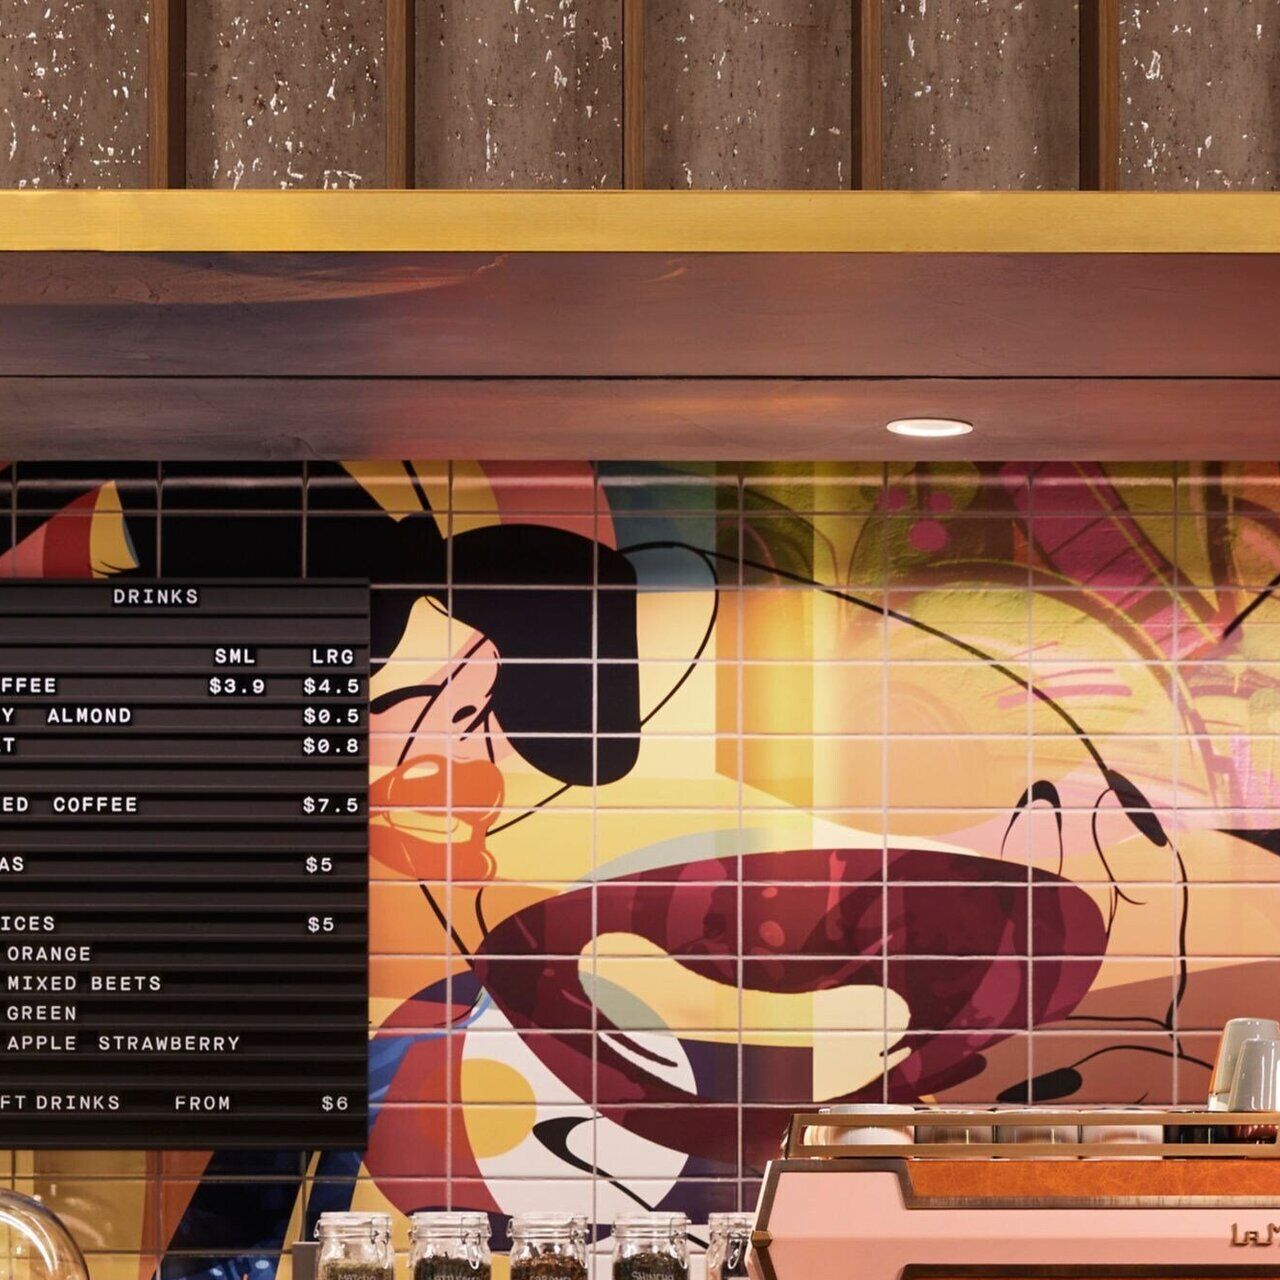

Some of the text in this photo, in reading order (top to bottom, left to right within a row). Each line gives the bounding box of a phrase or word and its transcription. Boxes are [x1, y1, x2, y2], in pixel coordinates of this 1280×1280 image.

[114, 589, 197, 604] DRINKS
[215, 648, 353, 664] SML LRG
[210, 677, 264, 694] $3.9
[304, 677, 358, 694] $4.5
[48, 708, 130, 723] ALMOND
[304, 707, 358, 724] $0.5
[304, 737, 358, 754] $0.8
[54, 797, 136, 812] COFFEE
[304, 797, 357, 813] $7.5
[306, 856, 332, 873] $5
[308, 917, 333, 933] $5
[8, 946, 89, 961] ORANGE
[8, 976, 160, 990] MIXED BEETS
[7, 1006, 75, 1020] GREEN
[8, 1036, 239, 1050] APPLE STRAWBERRY
[37, 1096, 119, 1109] DRINKS
[176, 1096, 229, 1110] FROM
[322, 1096, 347, 1111] $6
